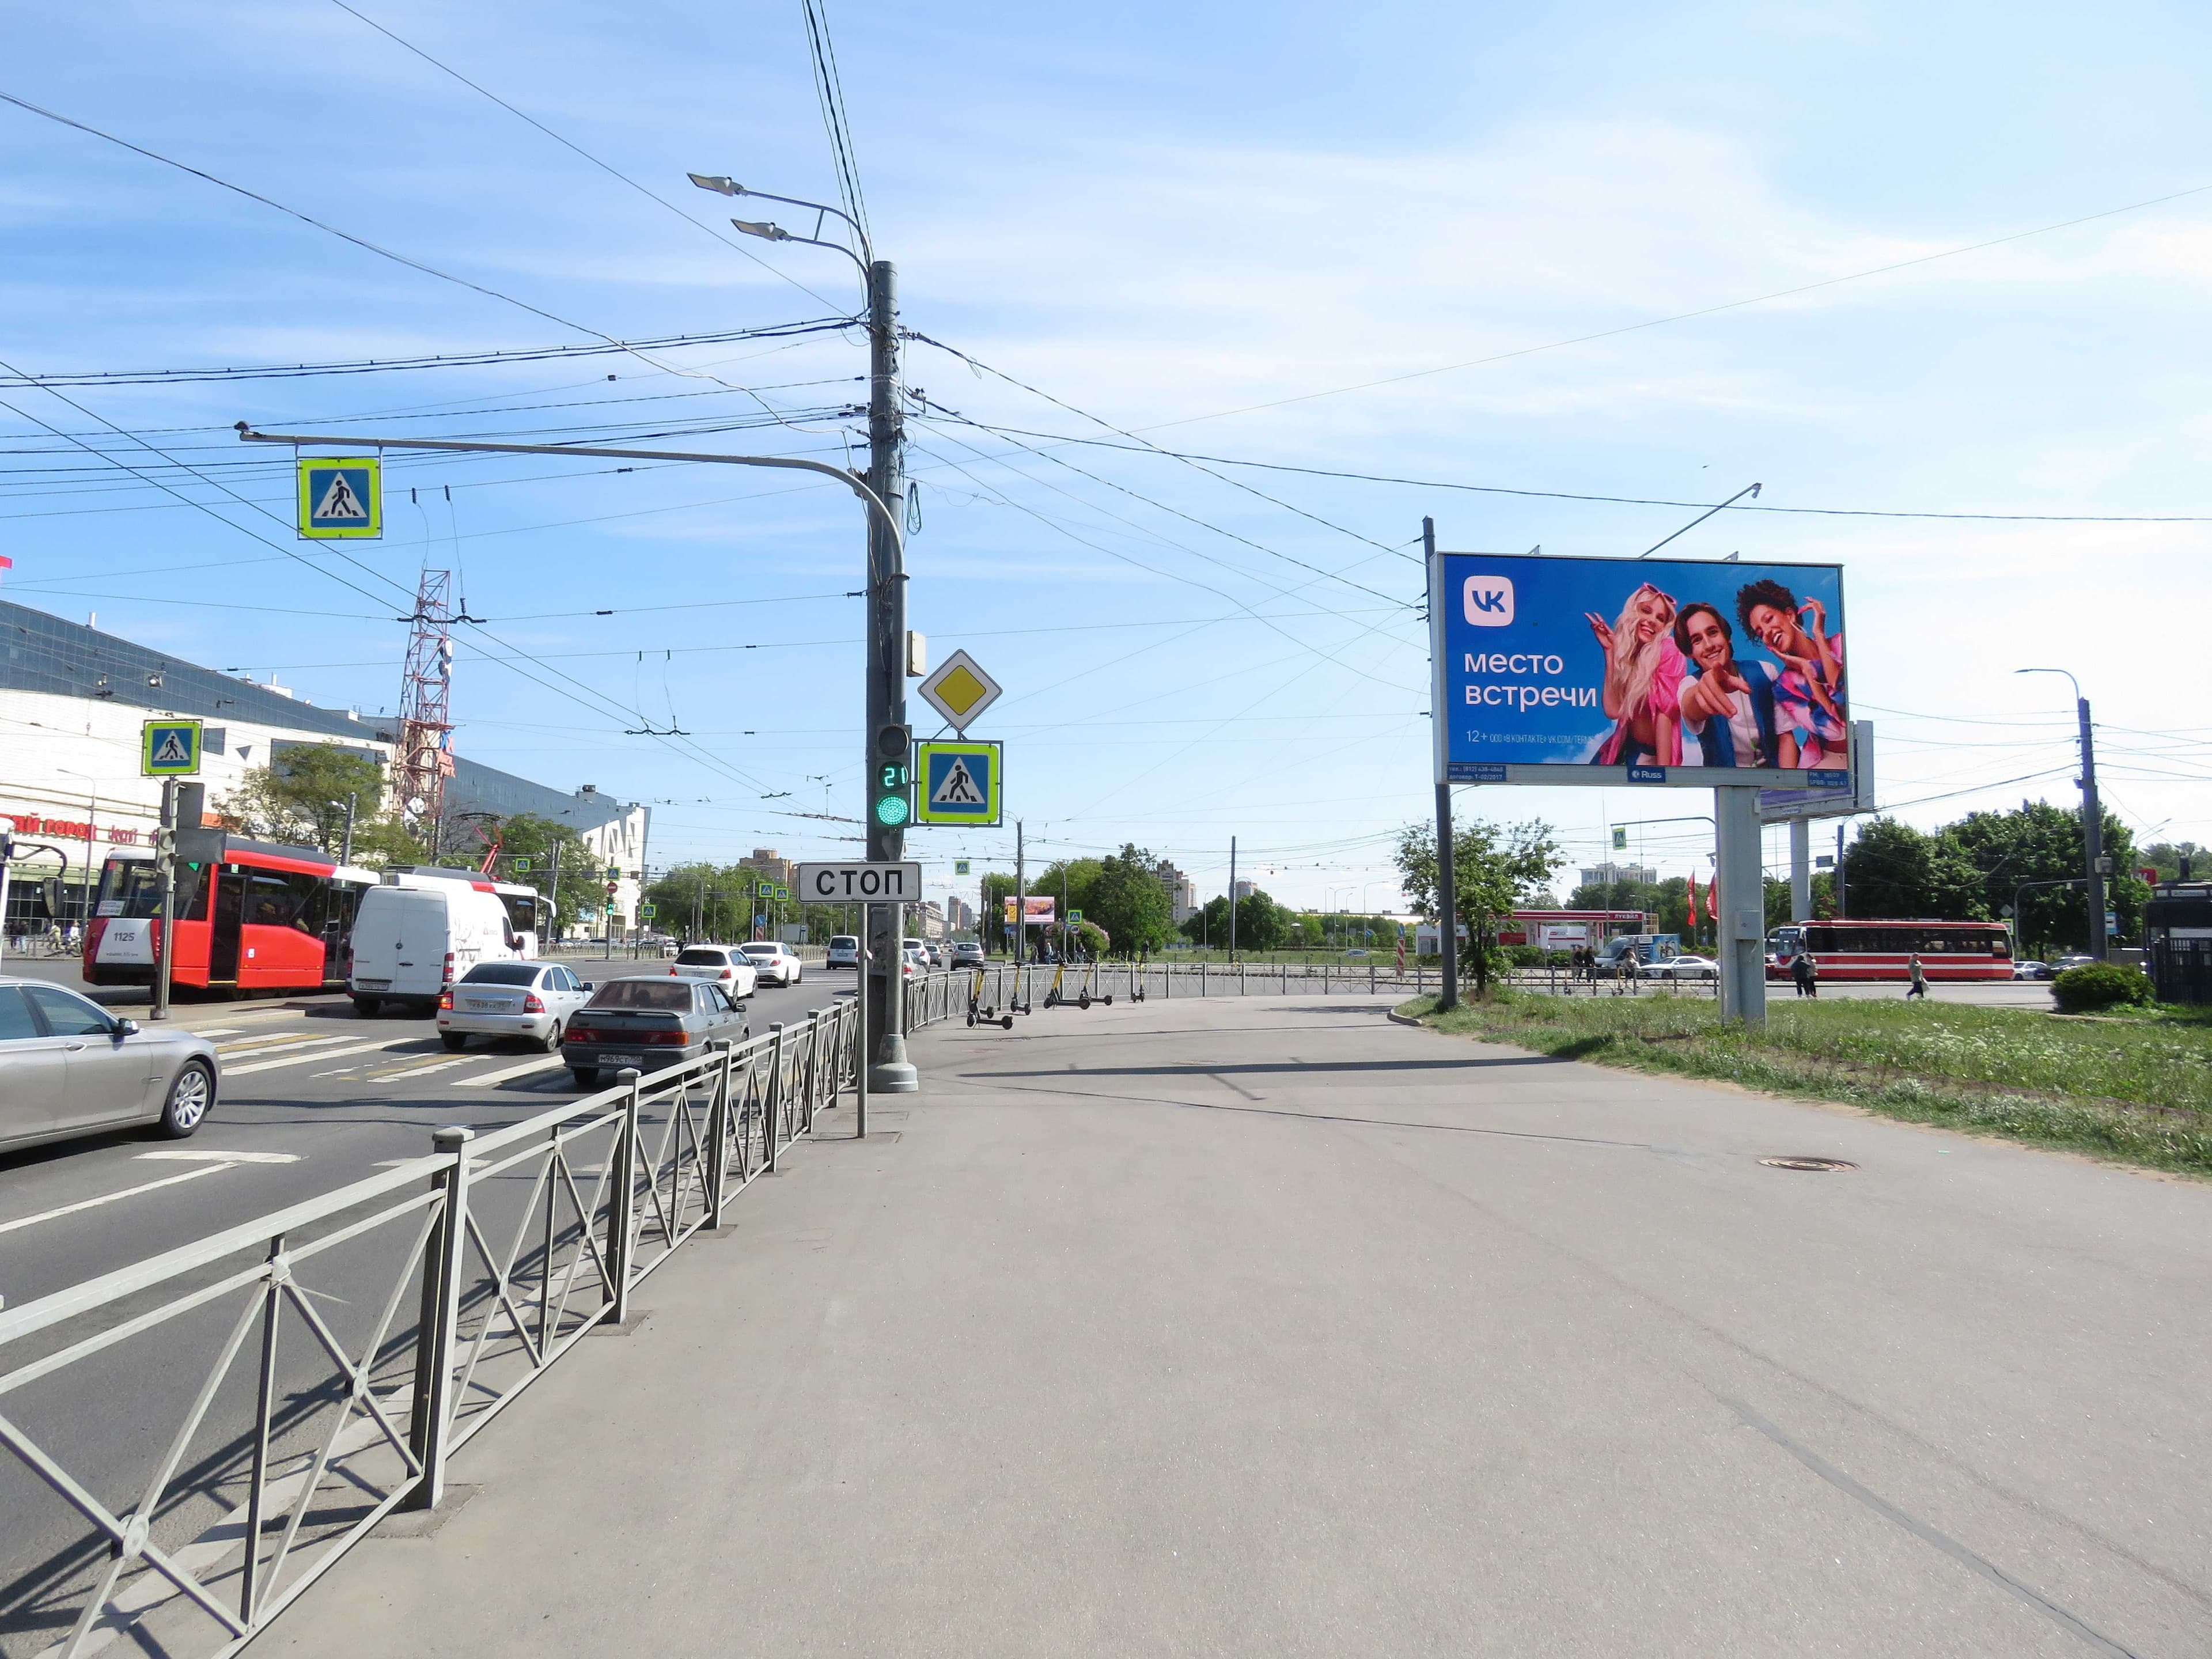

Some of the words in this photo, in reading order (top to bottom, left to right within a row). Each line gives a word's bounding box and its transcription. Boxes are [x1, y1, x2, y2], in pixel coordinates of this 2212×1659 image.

[1472, 590, 1506, 613] VK
[1465, 653, 1563, 675] место
[1465, 685, 1596, 713] встречи
[1466, 729, 1488, 743] 12+
[884, 767, 906, 787] 21
[1641, 770, 1662, 778] Russ
[816, 869, 903, 896] СТОП
[114, 932, 135, 942] 1125
